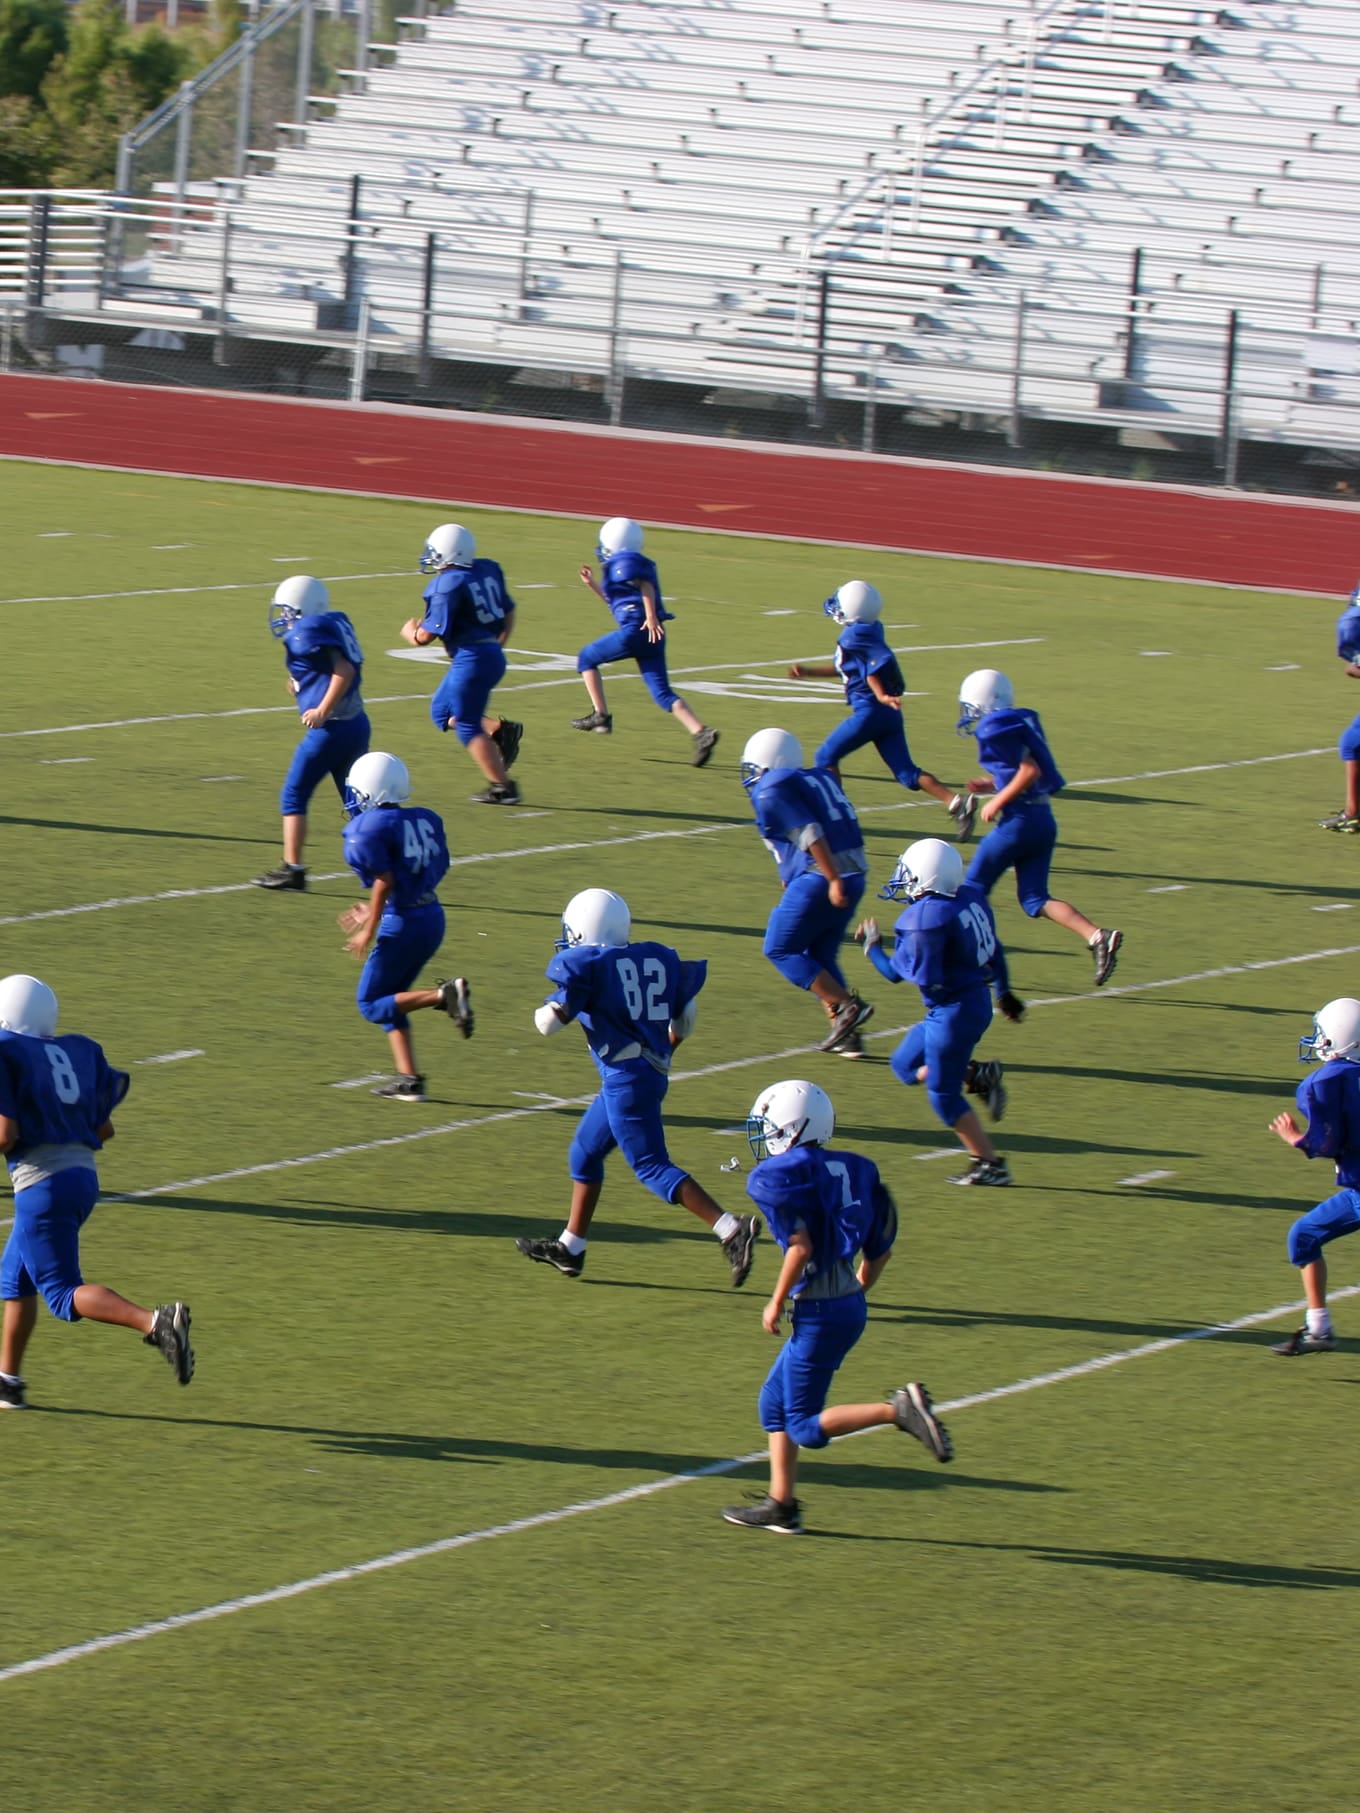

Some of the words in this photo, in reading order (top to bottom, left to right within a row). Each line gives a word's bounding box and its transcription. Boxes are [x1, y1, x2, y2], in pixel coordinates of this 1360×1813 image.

[468, 576, 506, 625] 50
[403, 817, 441, 874] 46
[616, 957, 670, 1021] 82
[44, 1043, 81, 1105] 8
